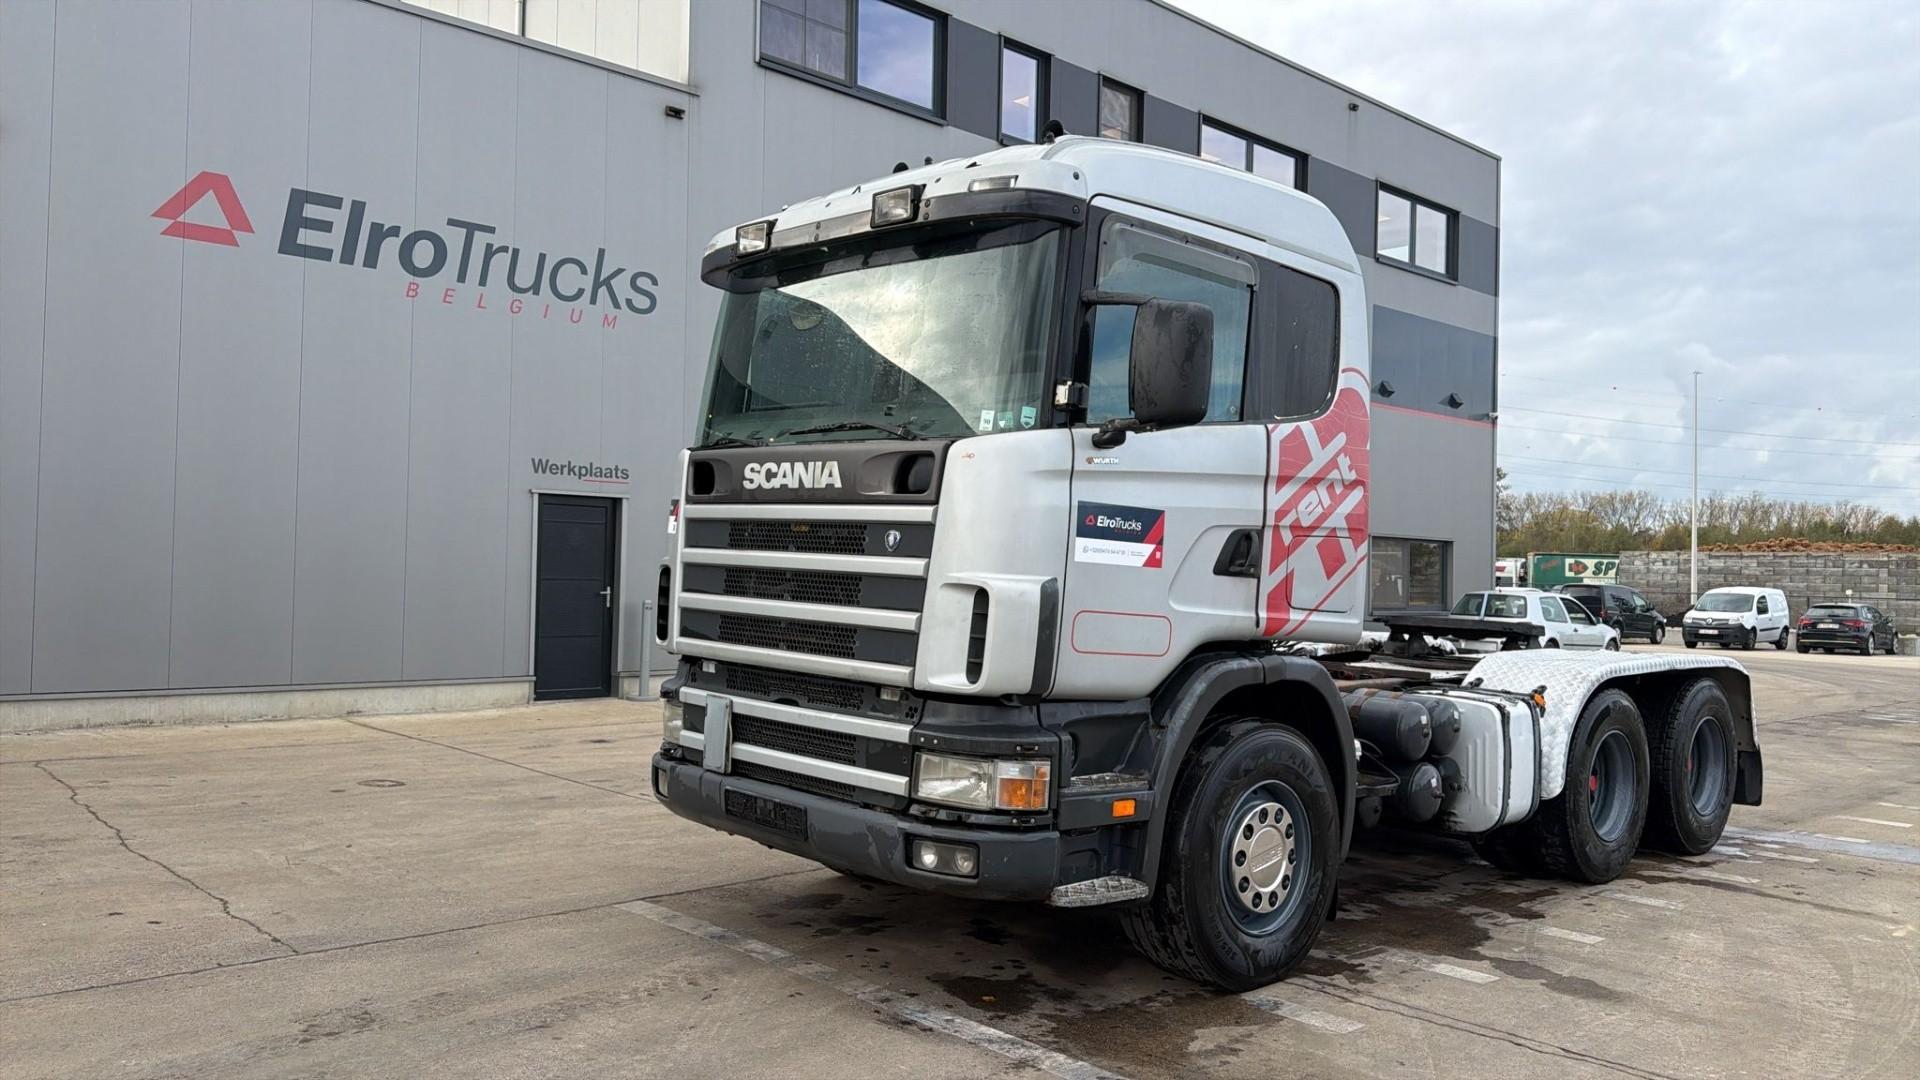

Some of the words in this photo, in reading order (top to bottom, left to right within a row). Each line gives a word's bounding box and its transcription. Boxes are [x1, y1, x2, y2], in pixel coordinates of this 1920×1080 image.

[277, 187, 660, 316] ElroTrucks
[406, 281, 618, 330] BELGIUM
[531, 457, 630, 480] Werkplaats
[742, 460, 843, 490] SCANIA
[1279, 453, 1358, 546] rent
[1096, 515, 1142, 532] ElroTrucks
